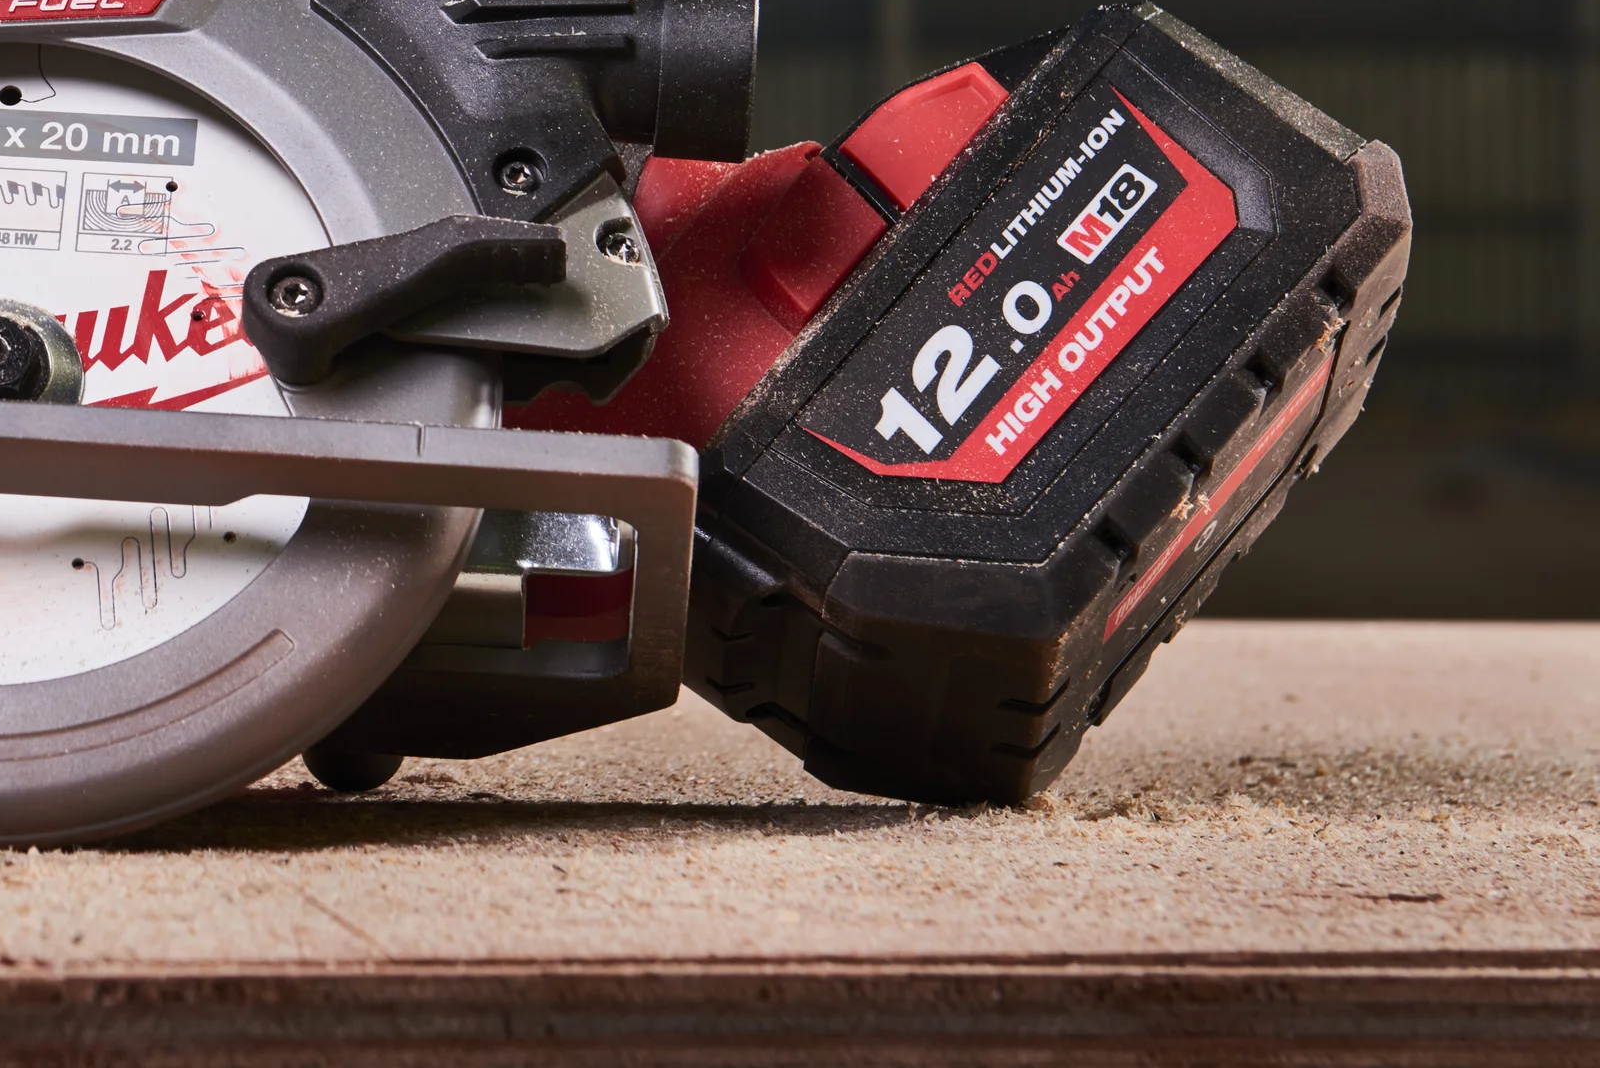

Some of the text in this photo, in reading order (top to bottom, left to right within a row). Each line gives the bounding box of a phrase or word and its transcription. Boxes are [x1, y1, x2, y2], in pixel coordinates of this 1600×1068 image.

[4, 126, 24, 149] x
[39, 122, 89, 151] 20
[102, 130, 180, 157] mm
[120, 194, 131, 205] A
[947, 108, 1126, 308] REDLITHIUM-ION
[1064, 171, 1146, 258] M18
[14, 233, 38, 246] HW
[110, 238, 133, 251] 2.2
[875, 269, 1081, 455] 12.0 Ah
[985, 246, 1166, 457] HIGH OUTPUT
